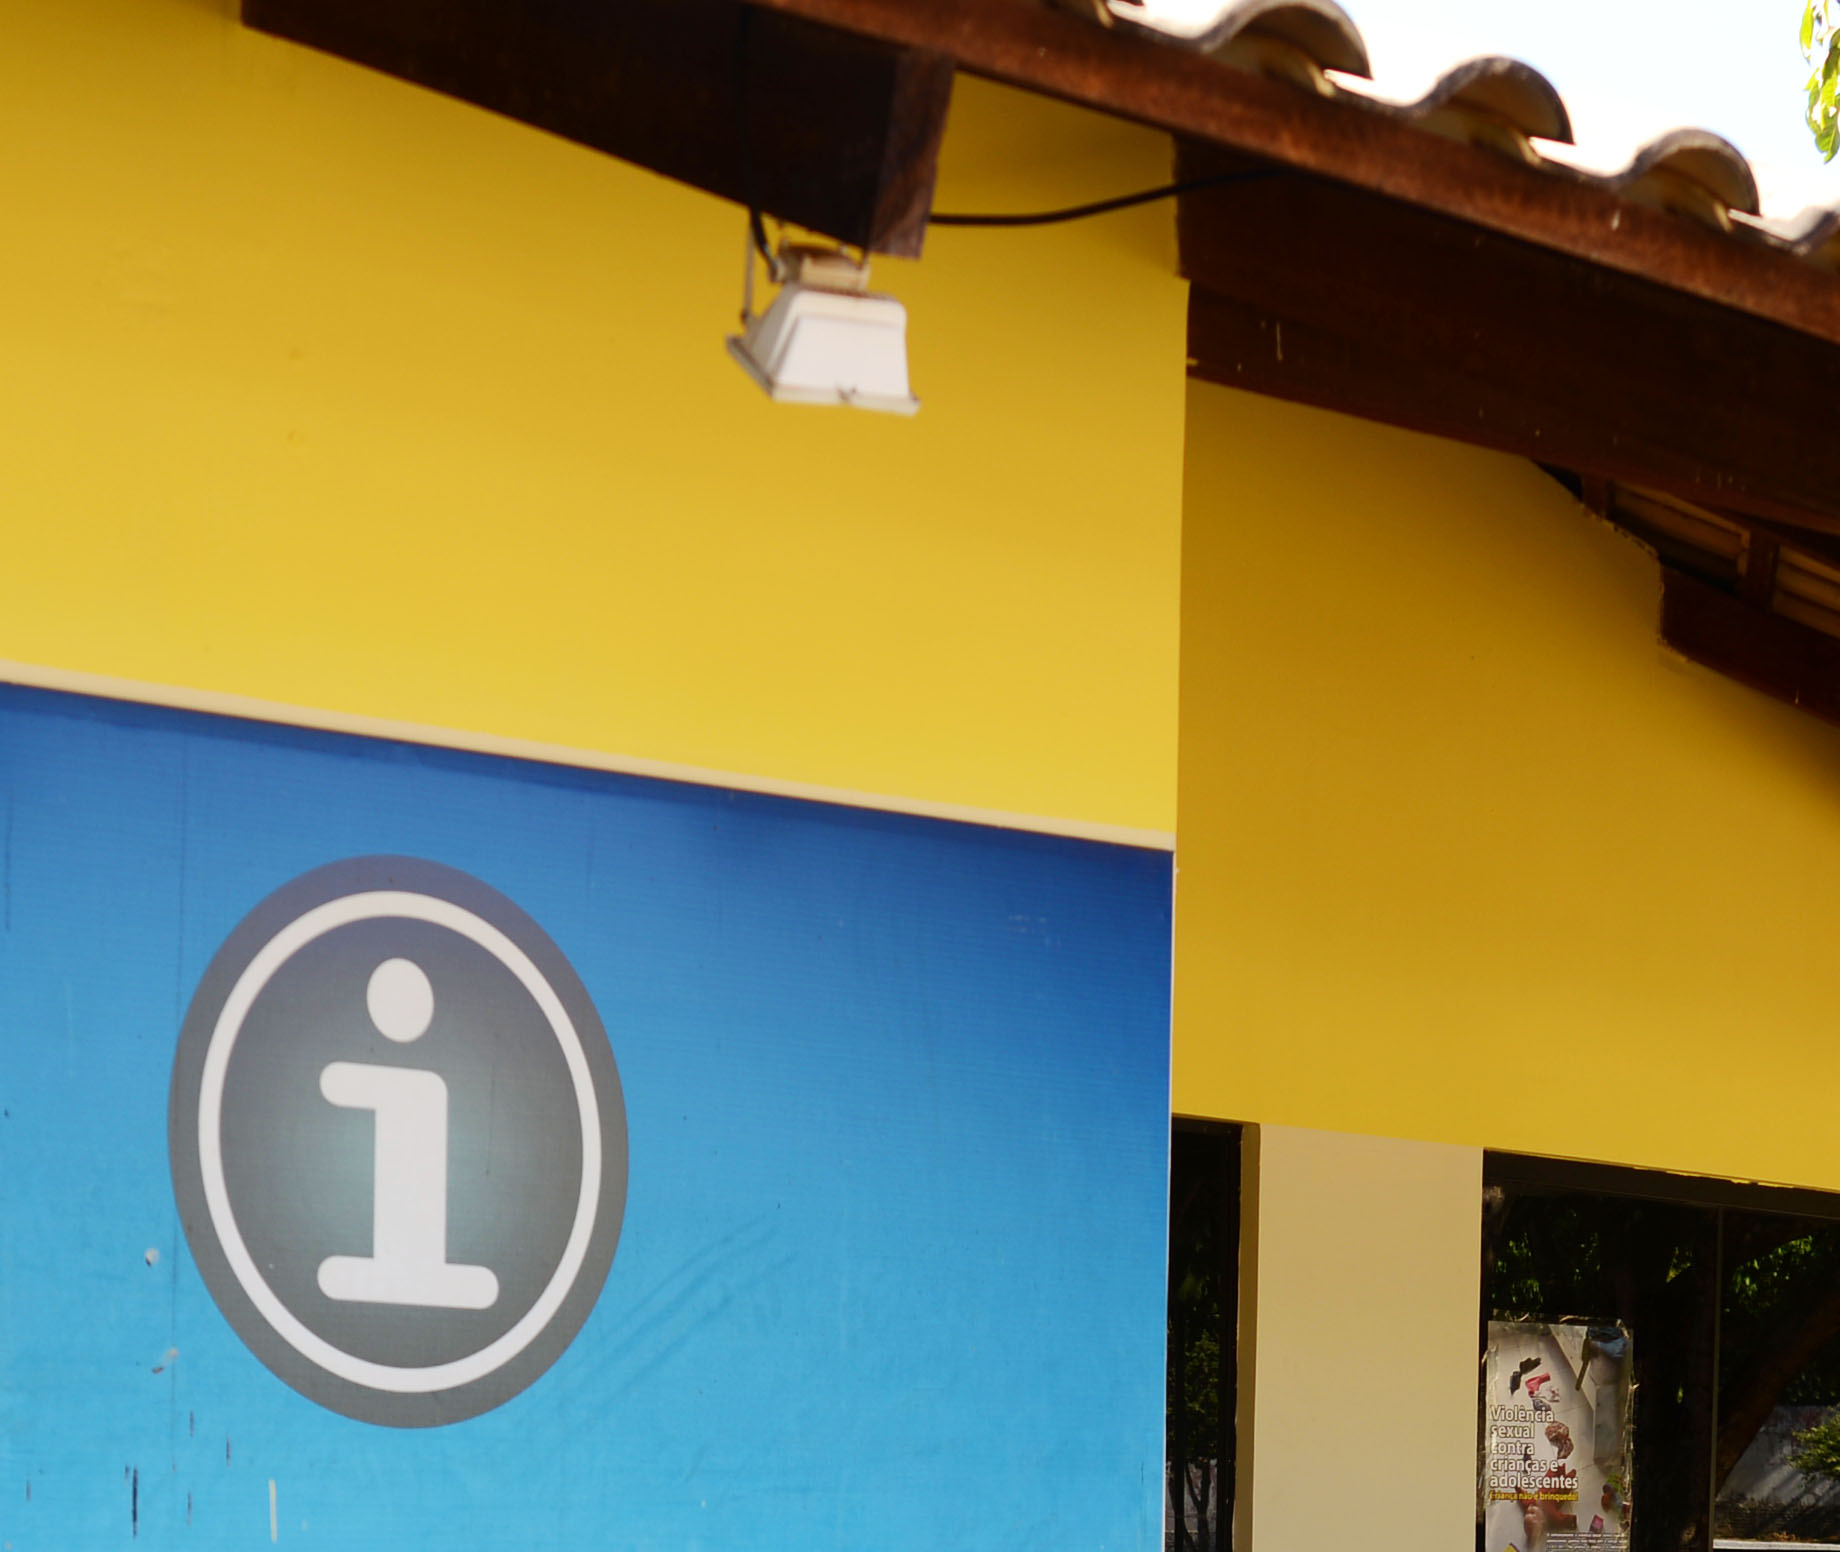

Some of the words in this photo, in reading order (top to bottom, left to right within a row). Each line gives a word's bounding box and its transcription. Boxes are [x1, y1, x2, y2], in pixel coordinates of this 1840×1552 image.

[1491, 1405, 1554, 1422] Violência
[1491, 1423, 1535, 1438] sexual
[1491, 1440, 1535, 1454] contra
[1490, 1455, 1547, 1476] crianças
[1550, 1459, 1558, 1472] e
[1490, 1472, 1579, 1489] adolescentes
